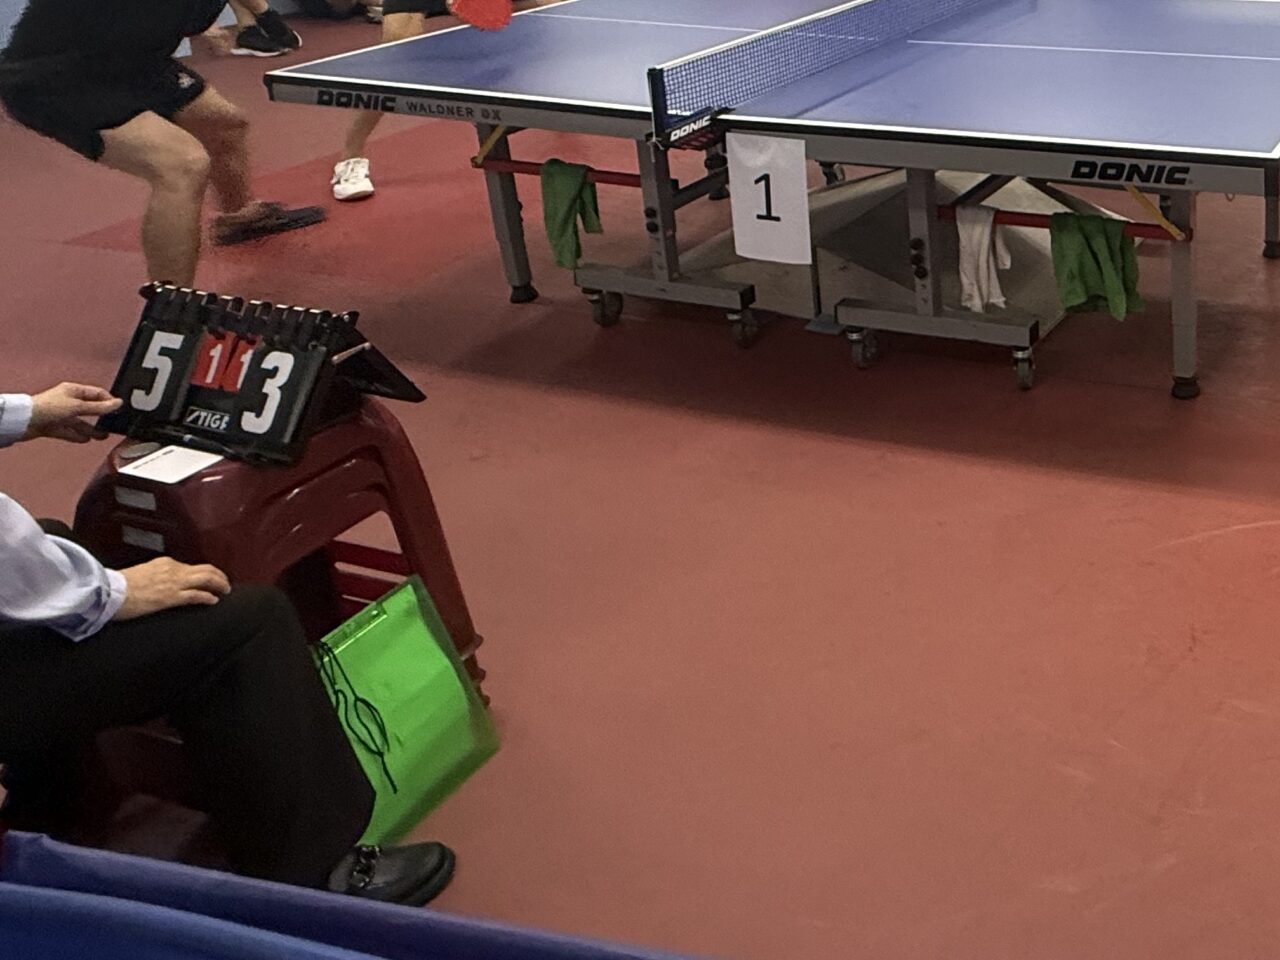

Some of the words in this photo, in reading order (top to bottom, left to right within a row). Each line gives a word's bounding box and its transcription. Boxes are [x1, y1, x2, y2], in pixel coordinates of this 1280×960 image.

[317, 90, 397, 112] DONIC
[406, 101, 474, 119] WALDNER
[670, 115, 712, 142] DONIC
[1071, 160, 1191, 185] DONIC
[754, 172, 782, 222] 1
[130, 330, 185, 412] 5
[240, 350, 295, 434] 3
